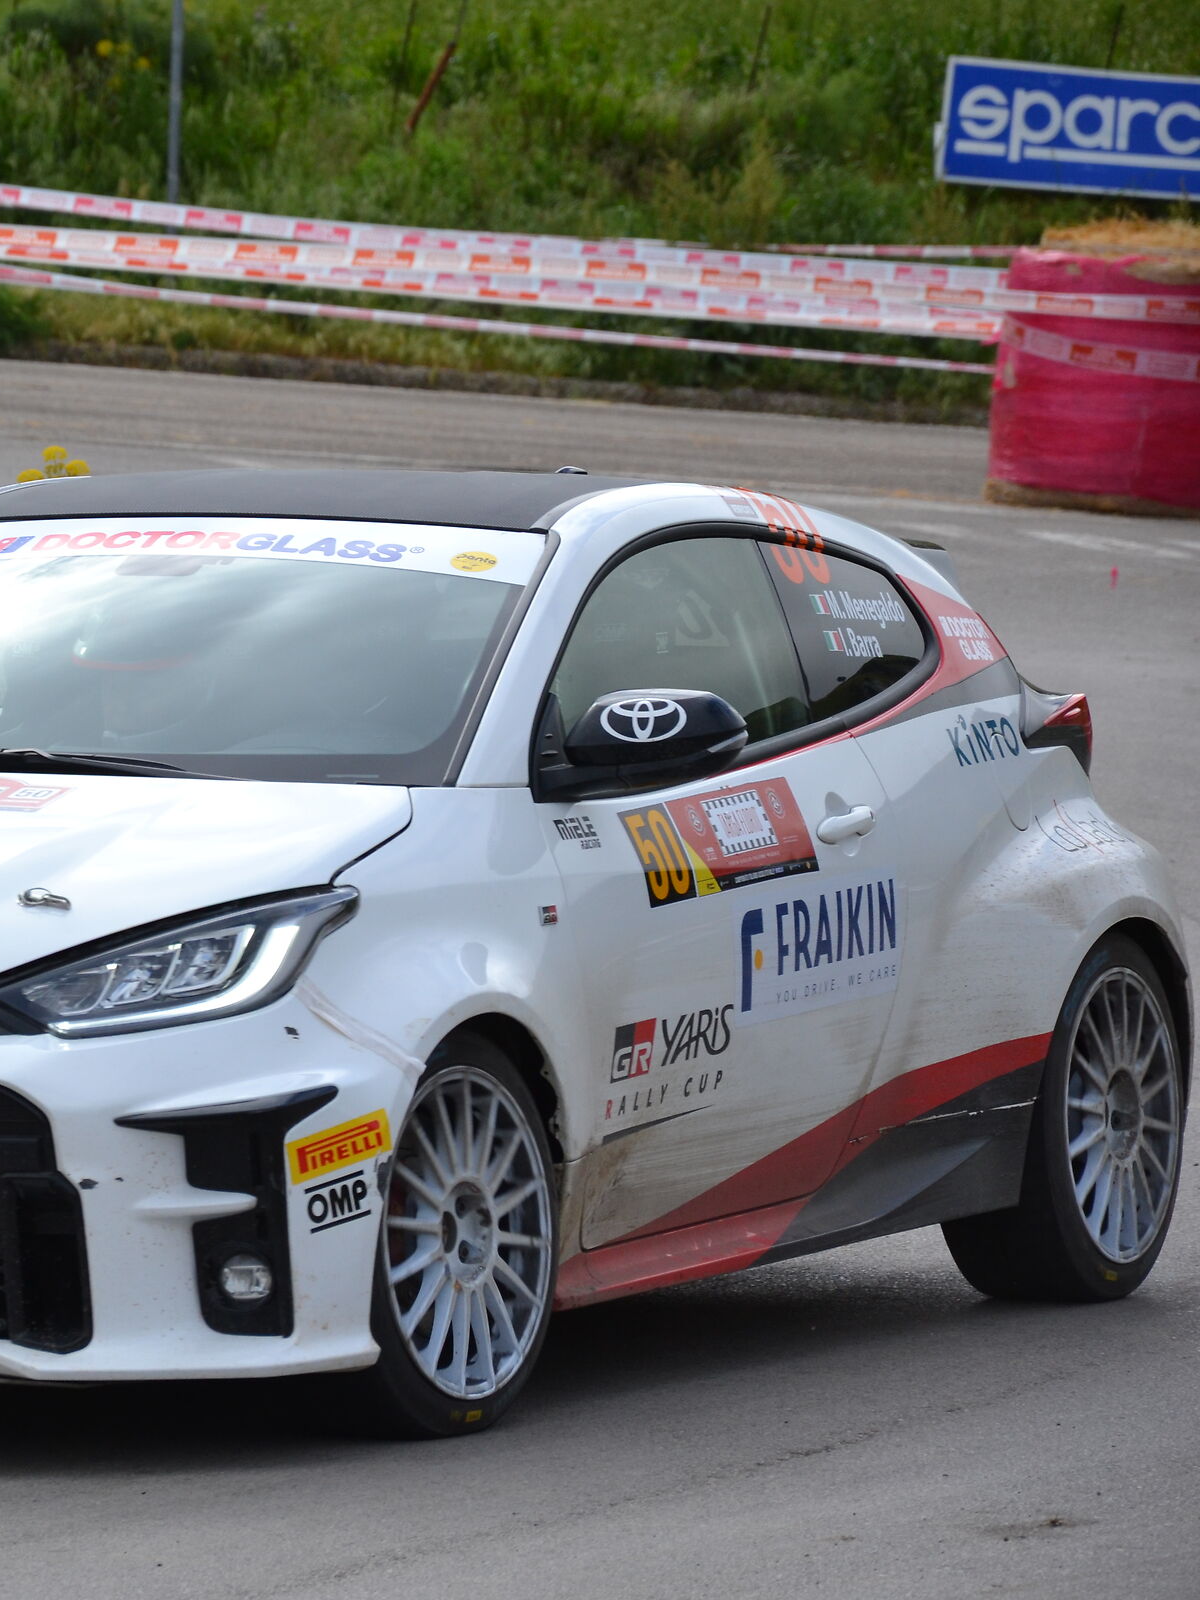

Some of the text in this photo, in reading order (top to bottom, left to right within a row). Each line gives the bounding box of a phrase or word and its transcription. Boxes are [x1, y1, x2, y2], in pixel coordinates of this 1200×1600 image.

[15, 788, 52, 799] 50
[625, 810, 693, 900] 50
[775, 879, 897, 976] FRAIKIN
[776, 988, 798, 1003] YOU
[847, 972, 862, 987] WE
[868, 964, 896, 982] CARE
[611, 1038, 654, 1080] GR
[605, 1069, 723, 1121] RALLY CUP
[296, 1119, 384, 1175] PIRELLI
[307, 1179, 368, 1224] OMP
